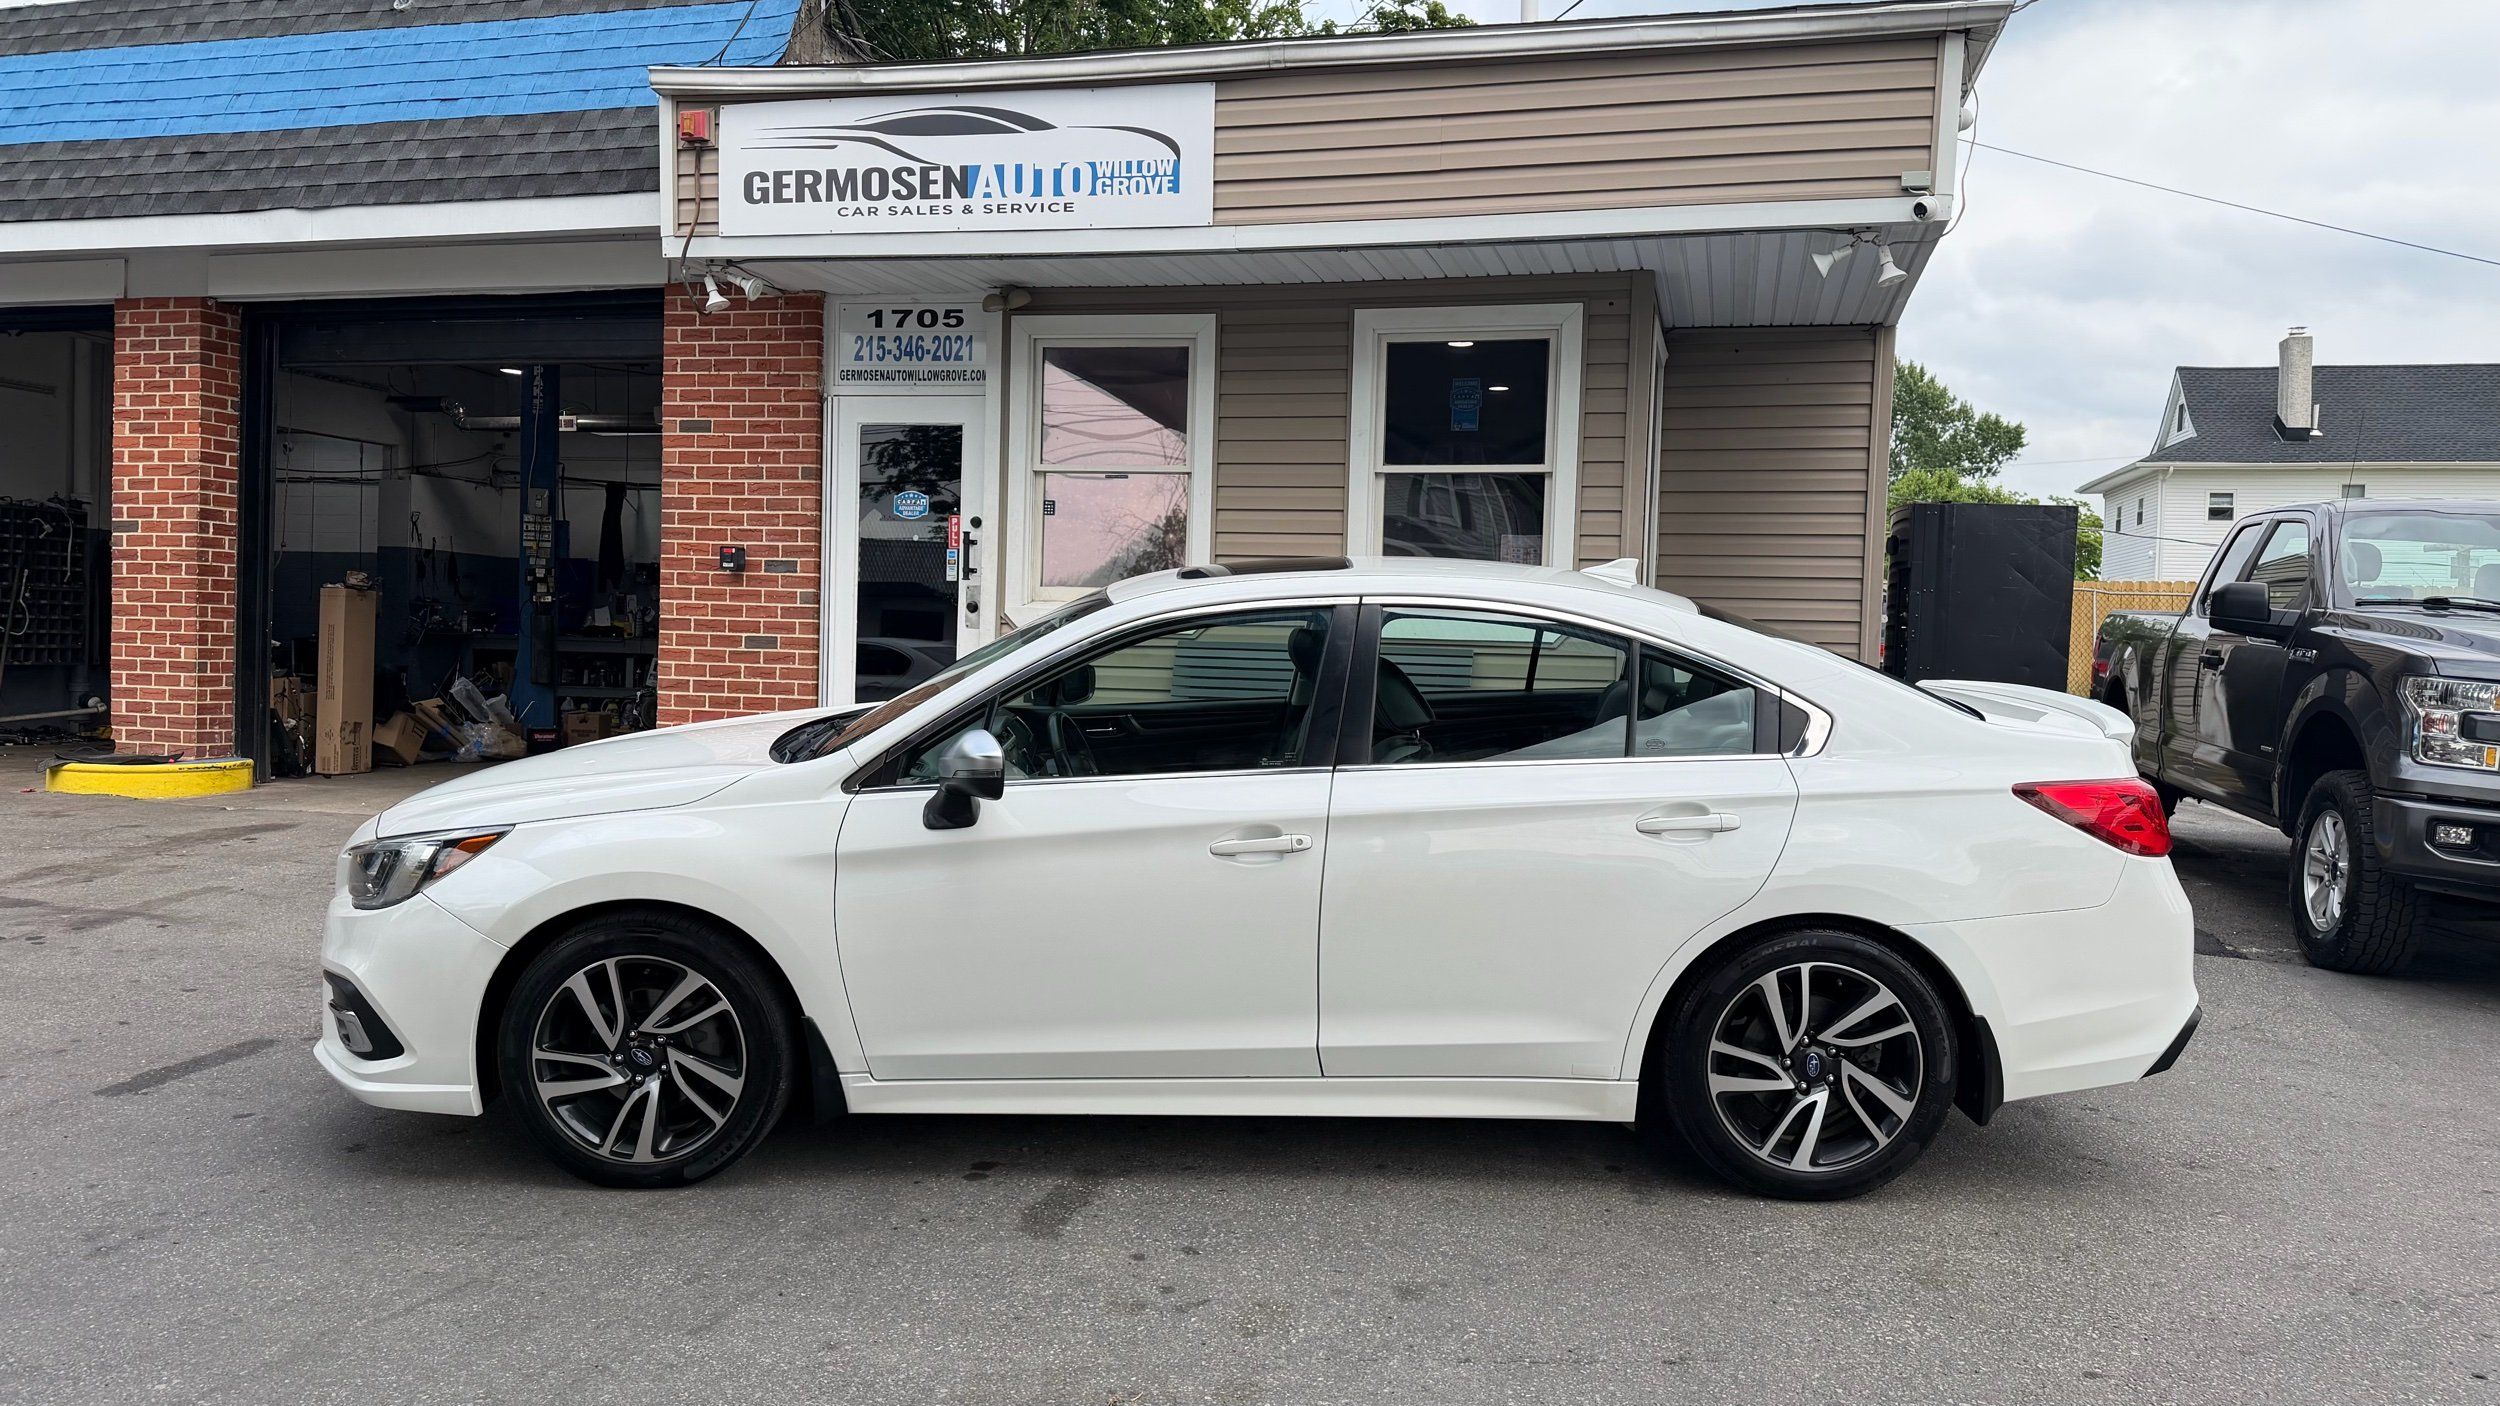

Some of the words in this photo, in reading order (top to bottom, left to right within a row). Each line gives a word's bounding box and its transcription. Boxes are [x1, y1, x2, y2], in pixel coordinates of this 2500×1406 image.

[1095, 158, 1175, 178] WILLOW
[743, 164, 968, 205] GERMOSEN
[971, 161, 1093, 199] AUTO
[1095, 176, 1174, 196] GROVE
[837, 206, 879, 217] CAR
[887, 204, 953, 216] SALES
[961, 204, 974, 215] &
[983, 202, 1075, 214] SERVICE
[867, 308, 965, 329] 1705
[853, 334, 974, 362] 215-346-2021
[839, 369, 987, 382] GERMOSENAUTOWILLOWGROVE.COM
